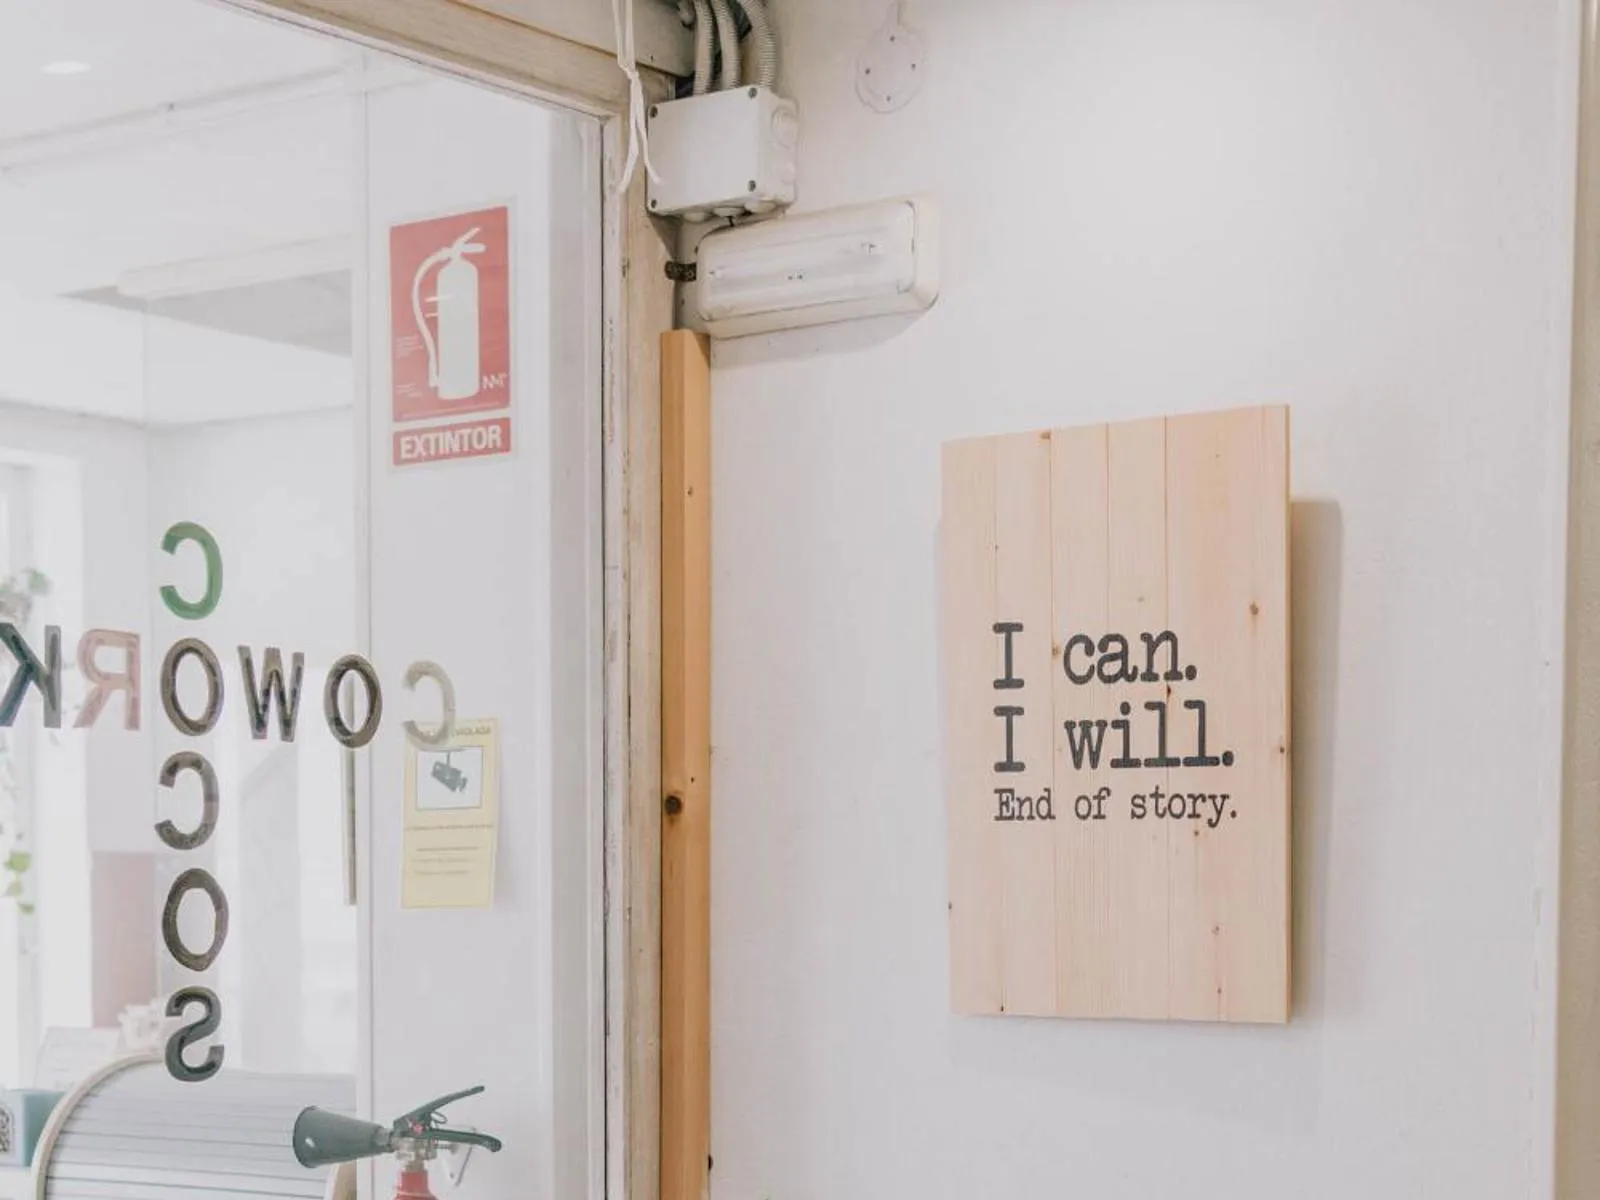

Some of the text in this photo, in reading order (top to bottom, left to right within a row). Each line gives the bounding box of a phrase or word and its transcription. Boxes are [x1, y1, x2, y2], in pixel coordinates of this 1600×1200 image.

[400, 424, 503, 460] EXTINTOR
[992, 622, 1198, 690] I can.
[993, 699, 1235, 773] I will.
[993, 785, 1238, 829] End of story.
